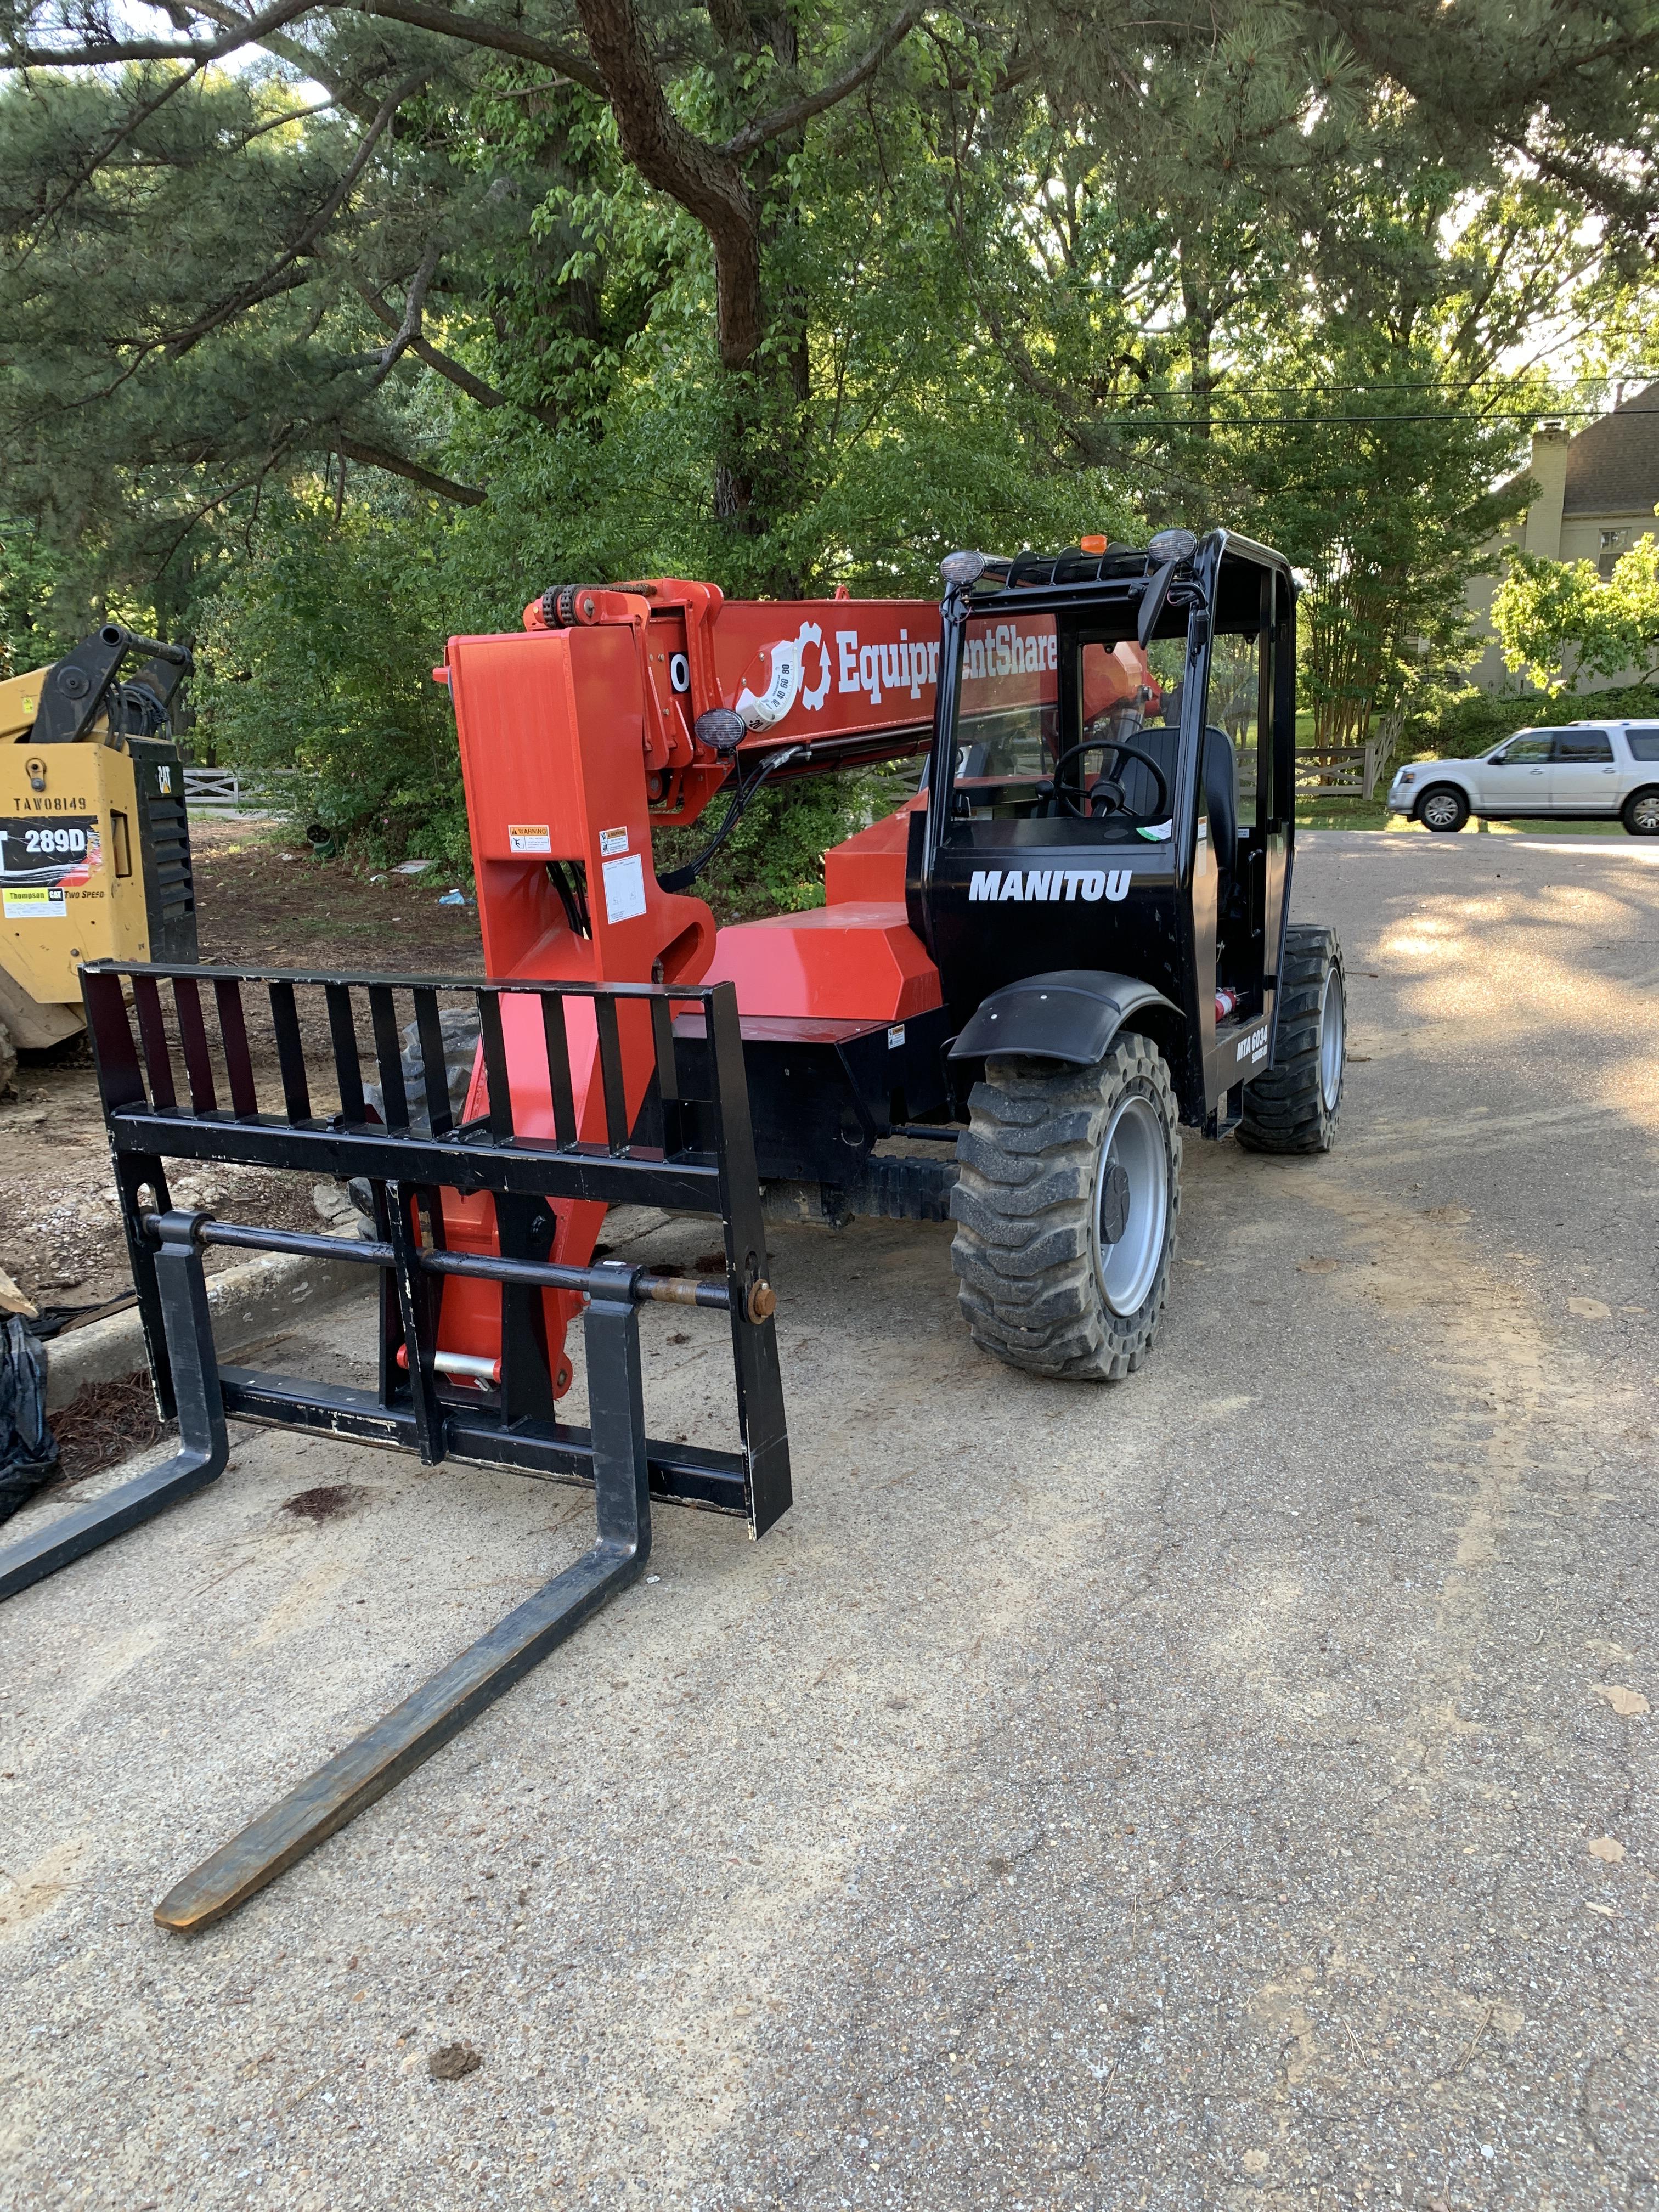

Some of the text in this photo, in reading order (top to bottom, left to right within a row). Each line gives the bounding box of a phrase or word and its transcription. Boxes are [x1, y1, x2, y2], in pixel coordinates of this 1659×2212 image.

[782, 664, 789, 675] 80
[780, 678, 789, 689] 60
[776, 690, 786, 699] 40
[771, 699, 780, 708] 20
[157, 765, 171, 793] CAT
[13, 797, 86, 811] TAW08149
[25, 828, 85, 853] 289D
[969, 870, 1132, 901] MANITOU
[1251, 1024, 1268, 1051] 6034
